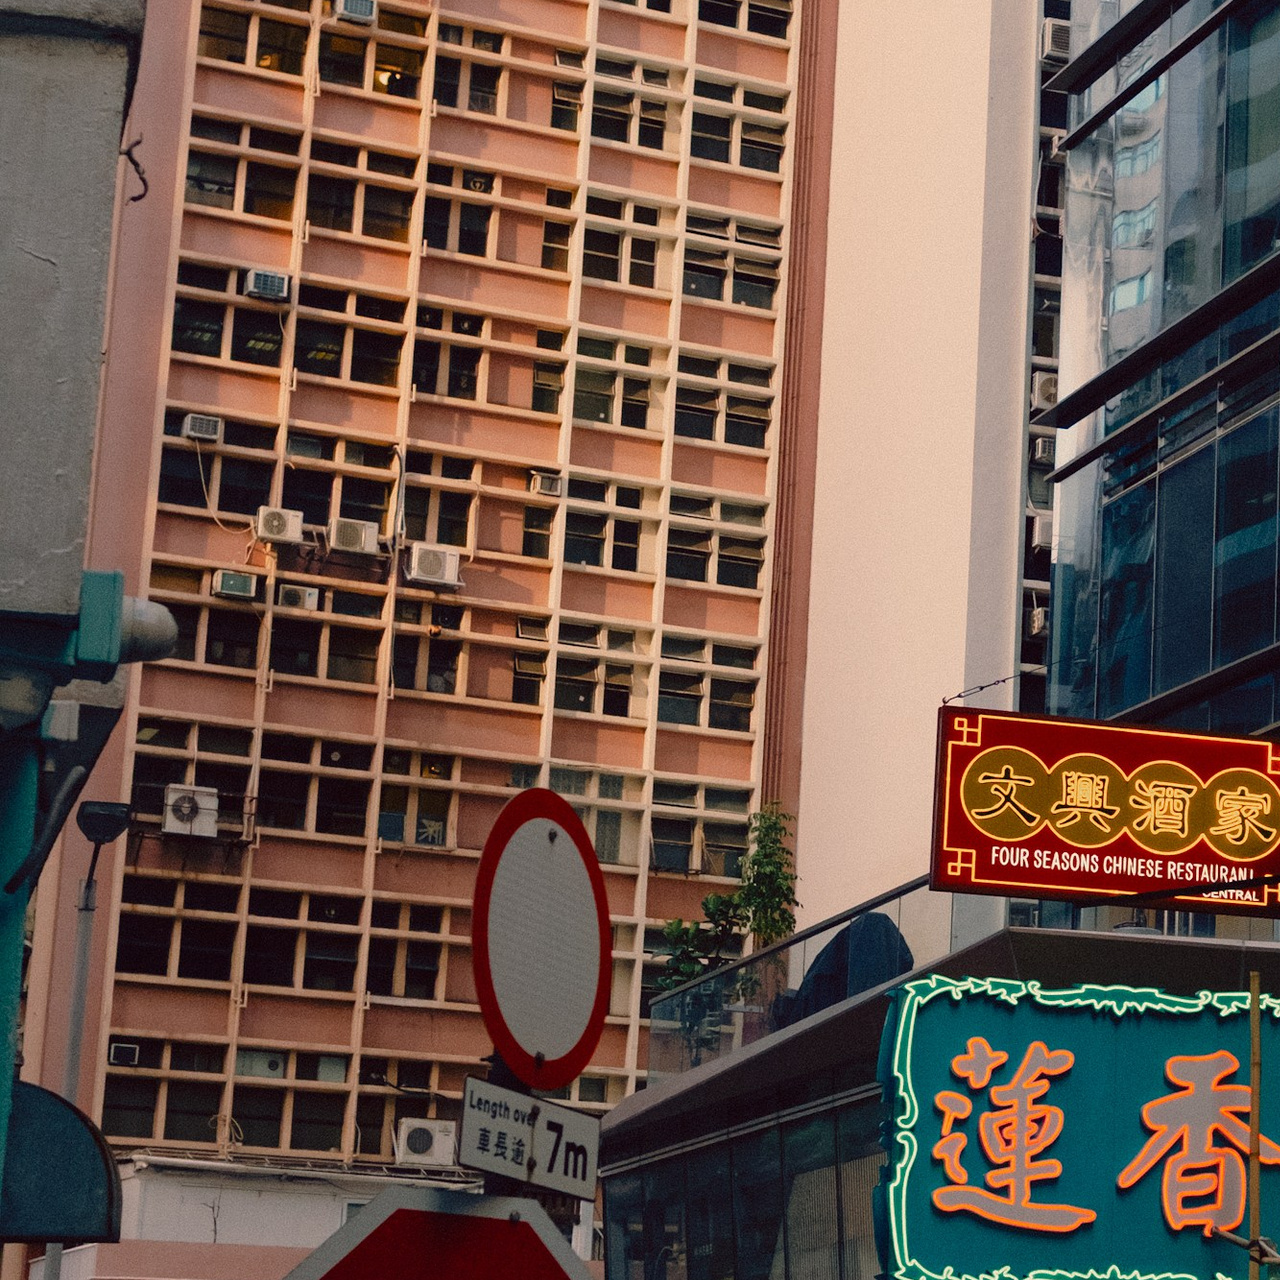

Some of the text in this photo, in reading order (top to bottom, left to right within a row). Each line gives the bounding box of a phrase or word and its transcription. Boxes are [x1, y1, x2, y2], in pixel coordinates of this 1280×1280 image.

[970, 764, 1277, 846] 文興酒家
[991, 846, 1029, 869] FOUR
[1033, 849, 1099, 874] SEASONS
[1102, 854, 1164, 879] CHINESE
[469, 1090, 538, 1127] Length ove
[546, 1120, 588, 1182] 7m
